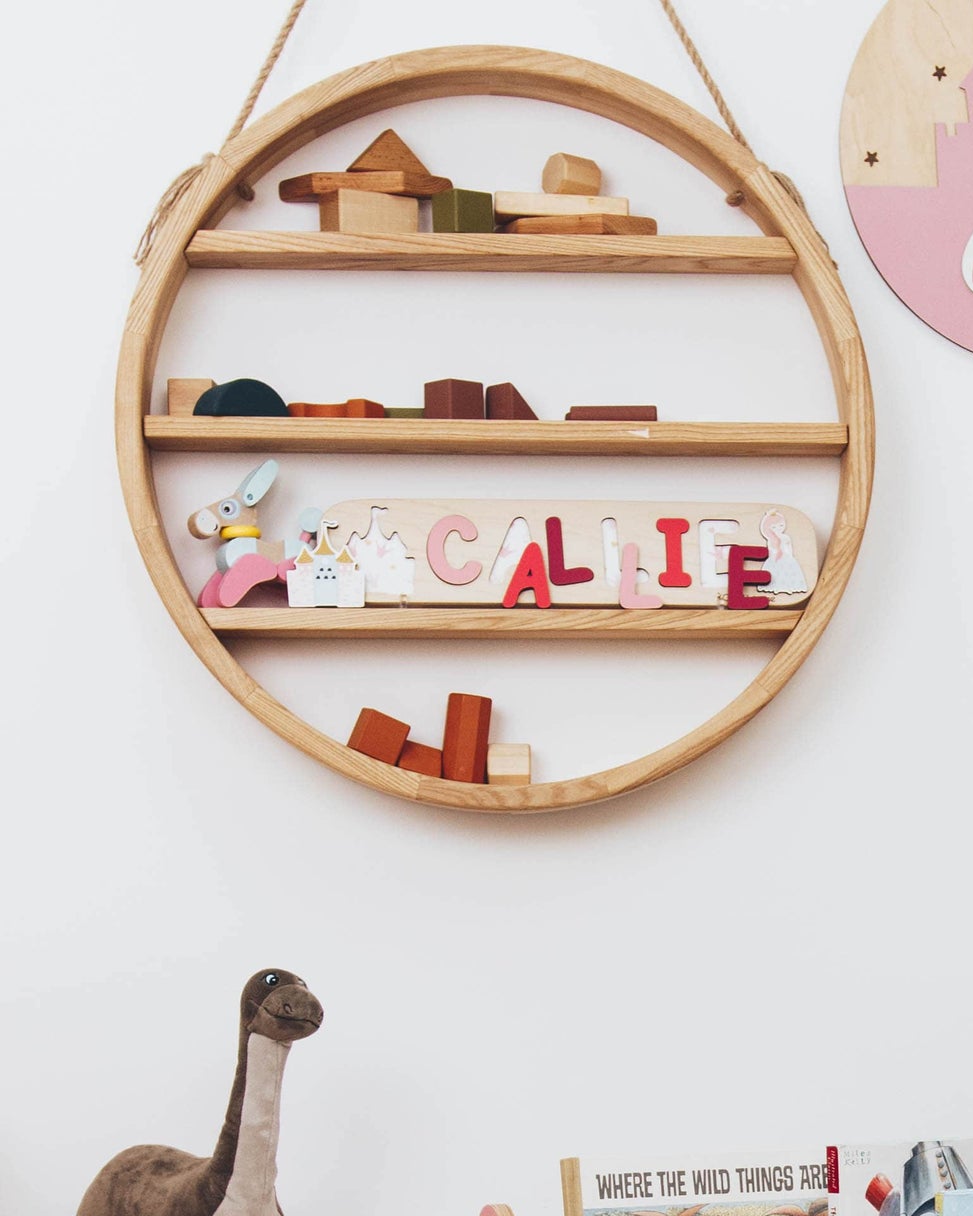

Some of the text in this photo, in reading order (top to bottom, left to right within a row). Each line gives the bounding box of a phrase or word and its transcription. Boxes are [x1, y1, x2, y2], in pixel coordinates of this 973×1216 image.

[595, 1164, 829, 1200] WHERE THE WILD THINGS ARE
